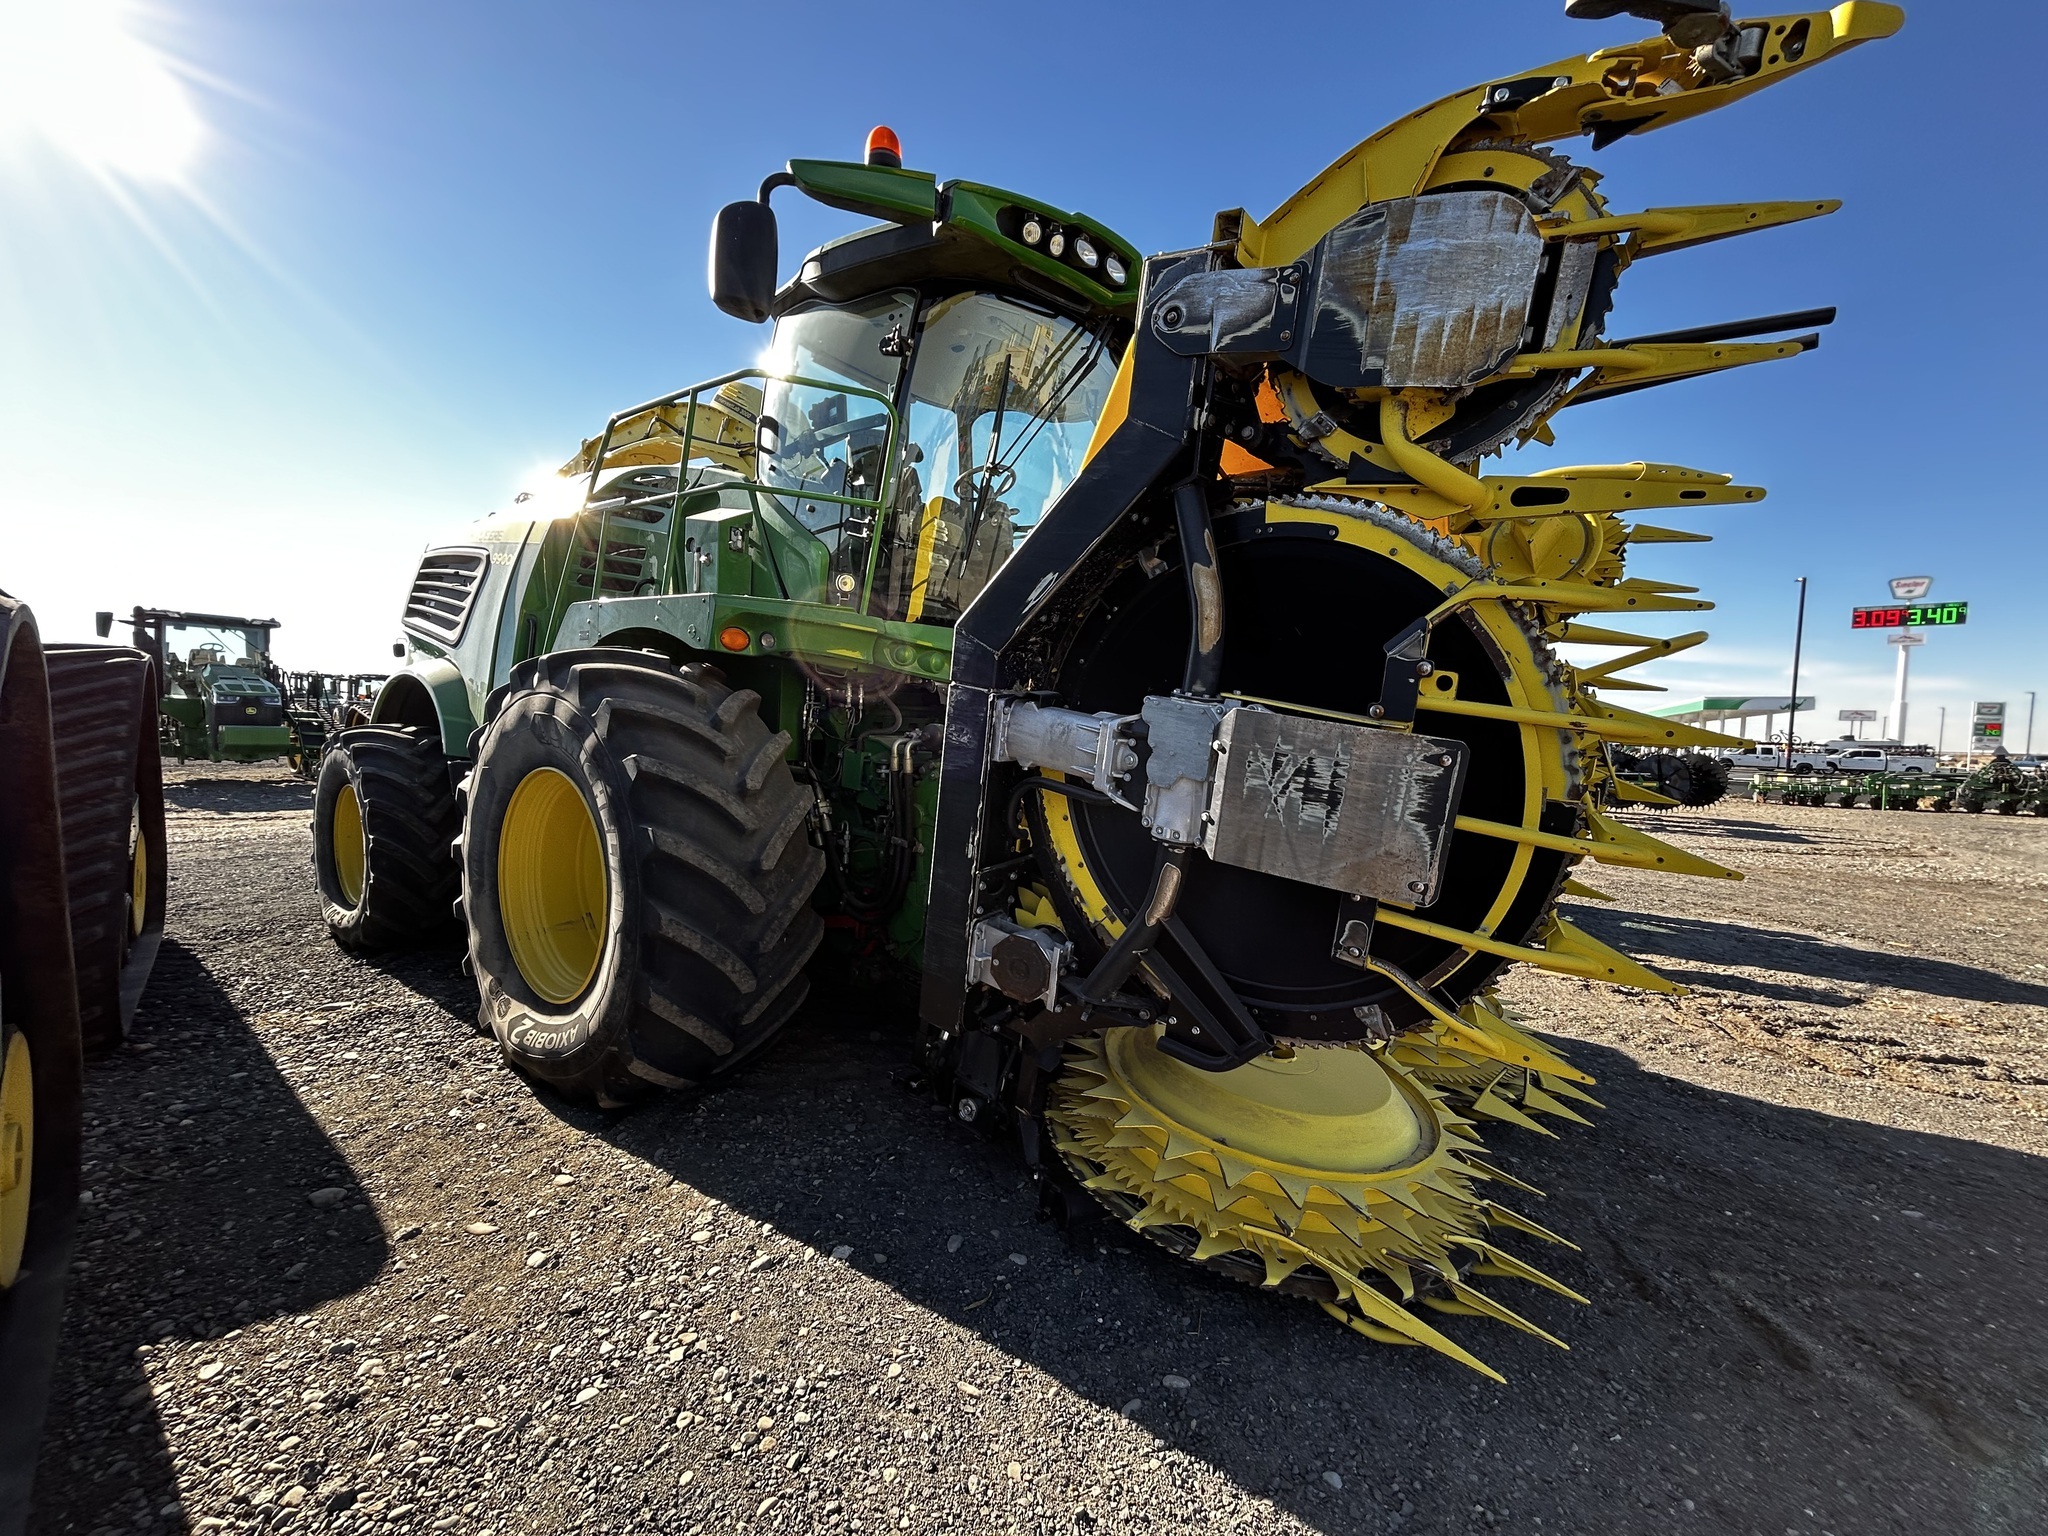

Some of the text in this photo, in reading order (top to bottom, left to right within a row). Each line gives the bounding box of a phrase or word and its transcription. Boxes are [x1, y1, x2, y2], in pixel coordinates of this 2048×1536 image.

[739, 408, 752, 419] 3000
[492, 552, 513, 566] 9900
[510, 1017, 580, 1051] AXIOBIB 2
